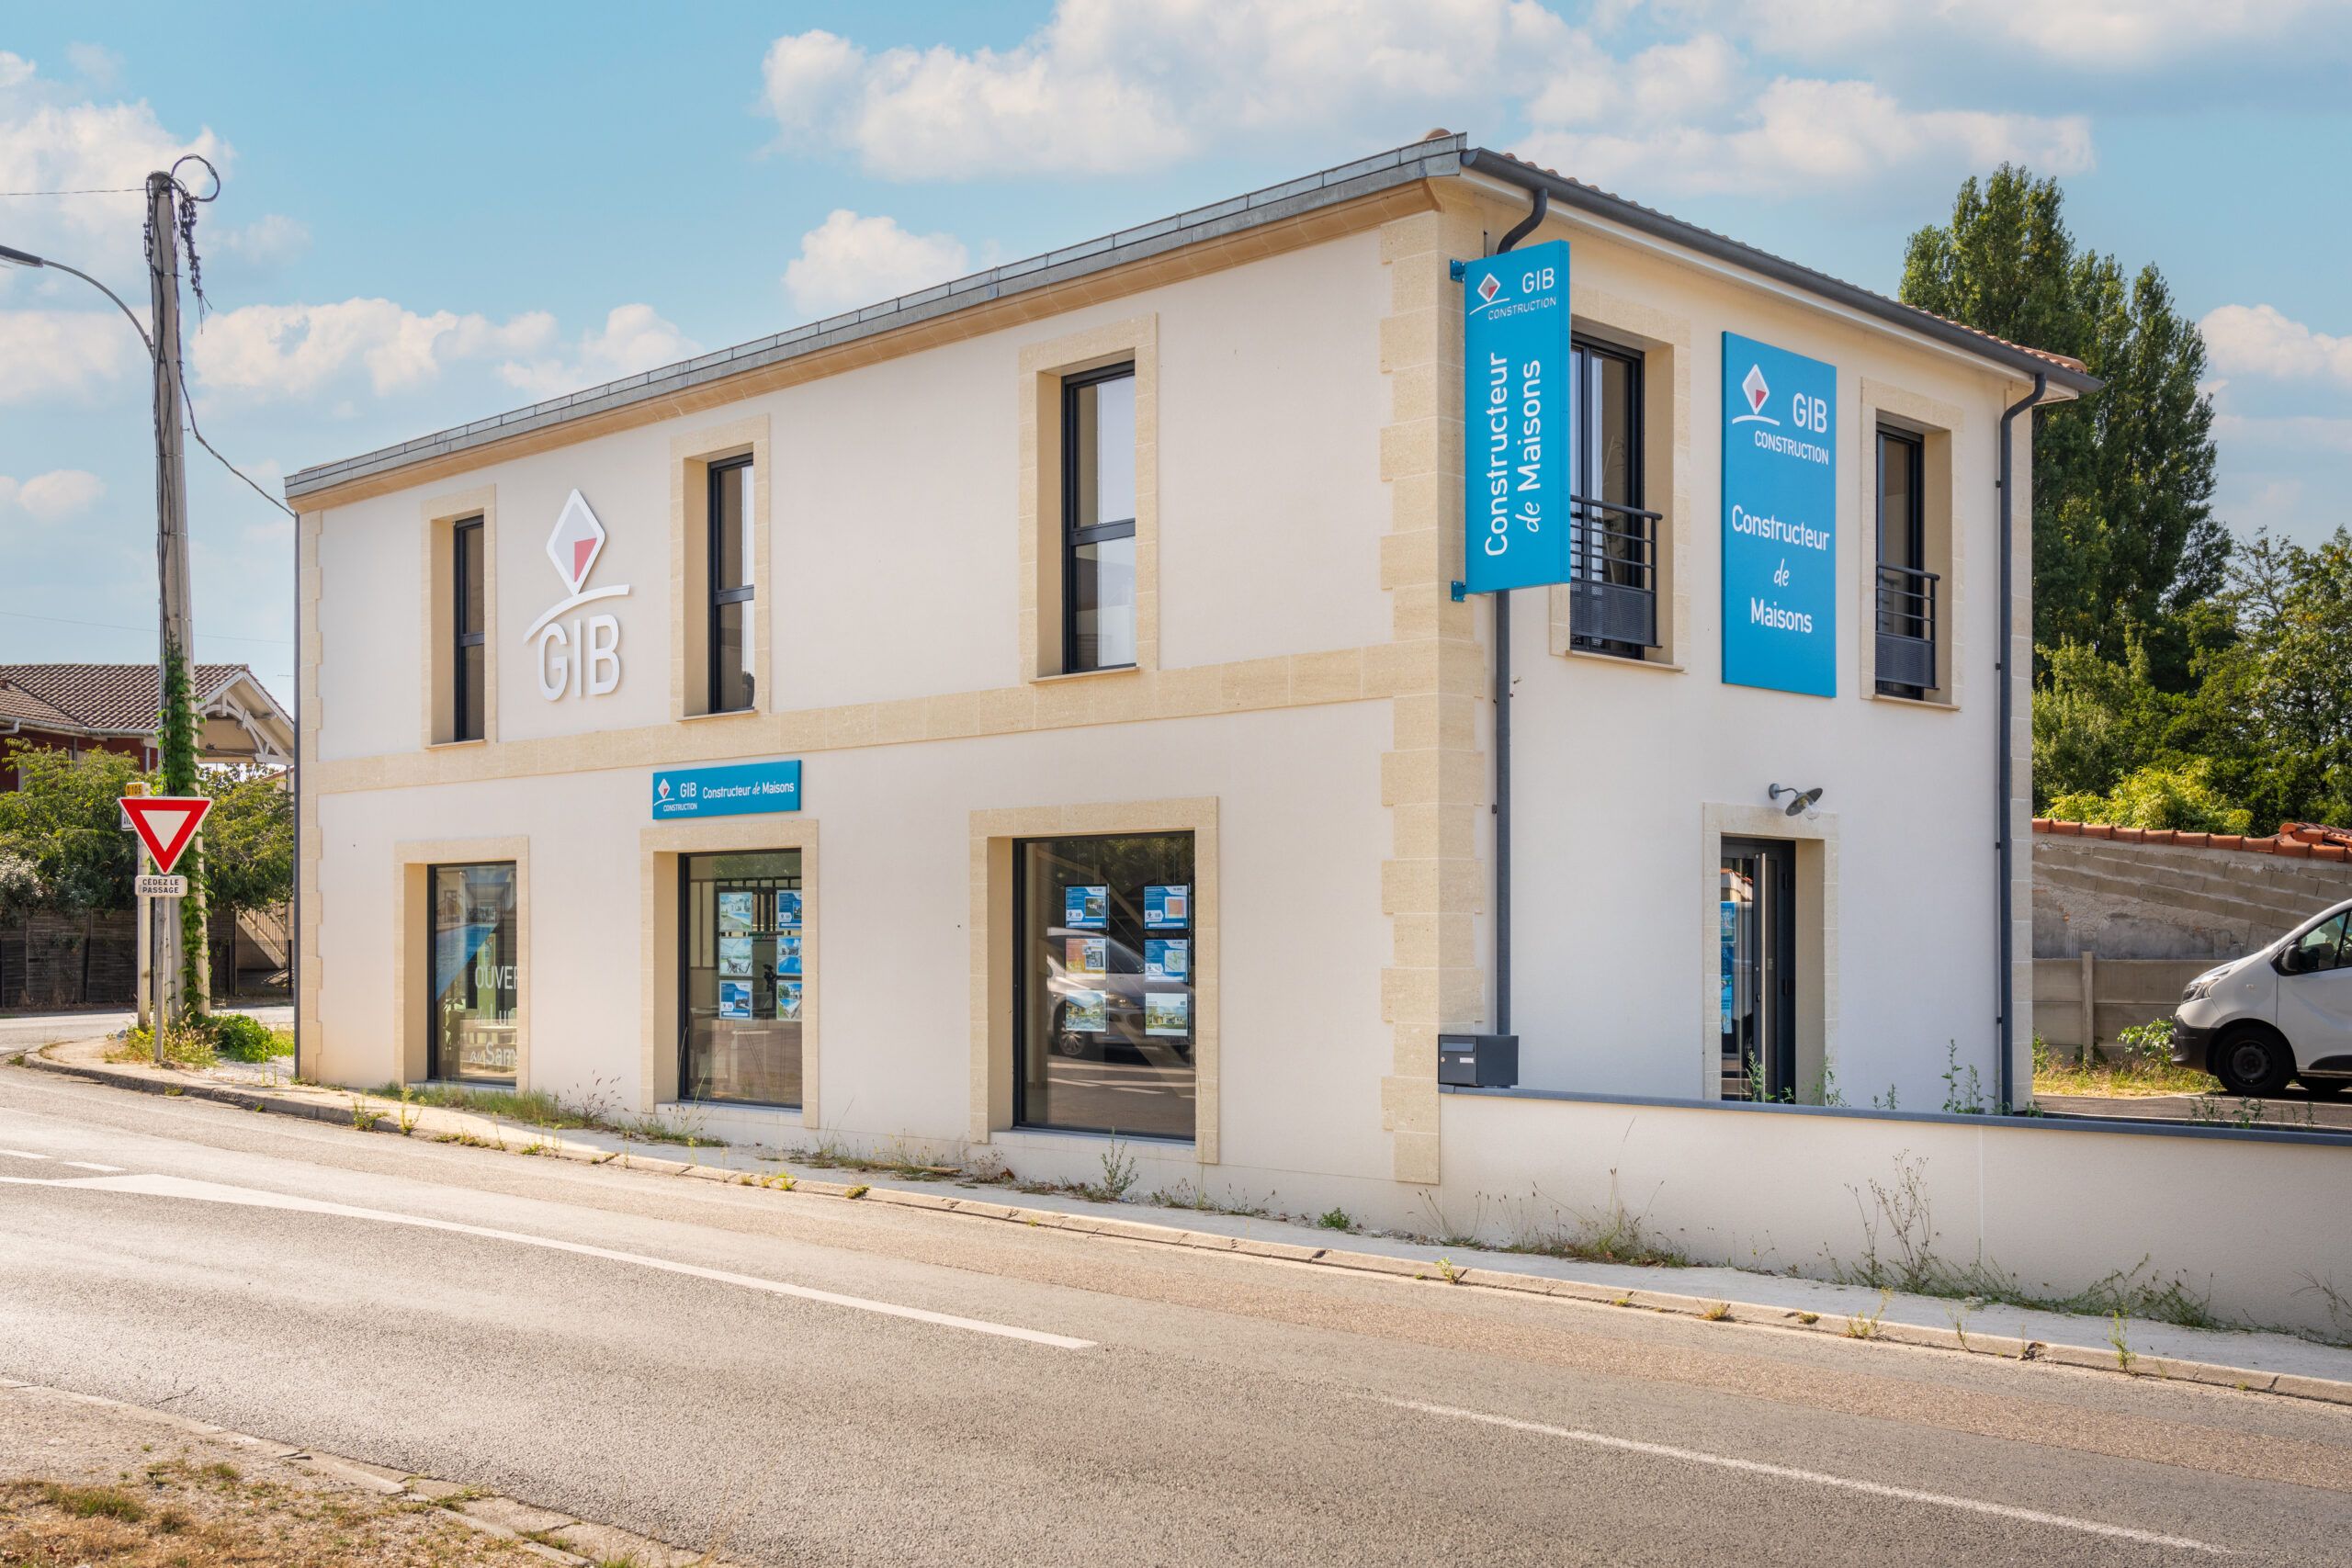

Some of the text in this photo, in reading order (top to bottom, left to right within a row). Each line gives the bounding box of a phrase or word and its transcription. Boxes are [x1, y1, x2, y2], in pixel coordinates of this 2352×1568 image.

[1522, 267, 1555, 294] GIB
[1488, 297, 1556, 321] CONSTRUCTION
[1792, 392, 1827, 434] GIB
[1485, 353, 1508, 556] Constructeur
[1515, 359, 1541, 532] de Maisons
[1755, 430, 1829, 466] CONSTRUCTION
[1732, 504, 1830, 551] Constructeur
[1773, 558, 1790, 587] de
[1750, 597, 1813, 634] Maisons
[538, 614, 620, 701] GIB
[680, 782, 696, 798] GIB
[702, 781, 795, 799] Constructeur de Maisons
[663, 802, 697, 812] CONSTRUCTION
[142, 877, 168, 886] CÉDEZ
